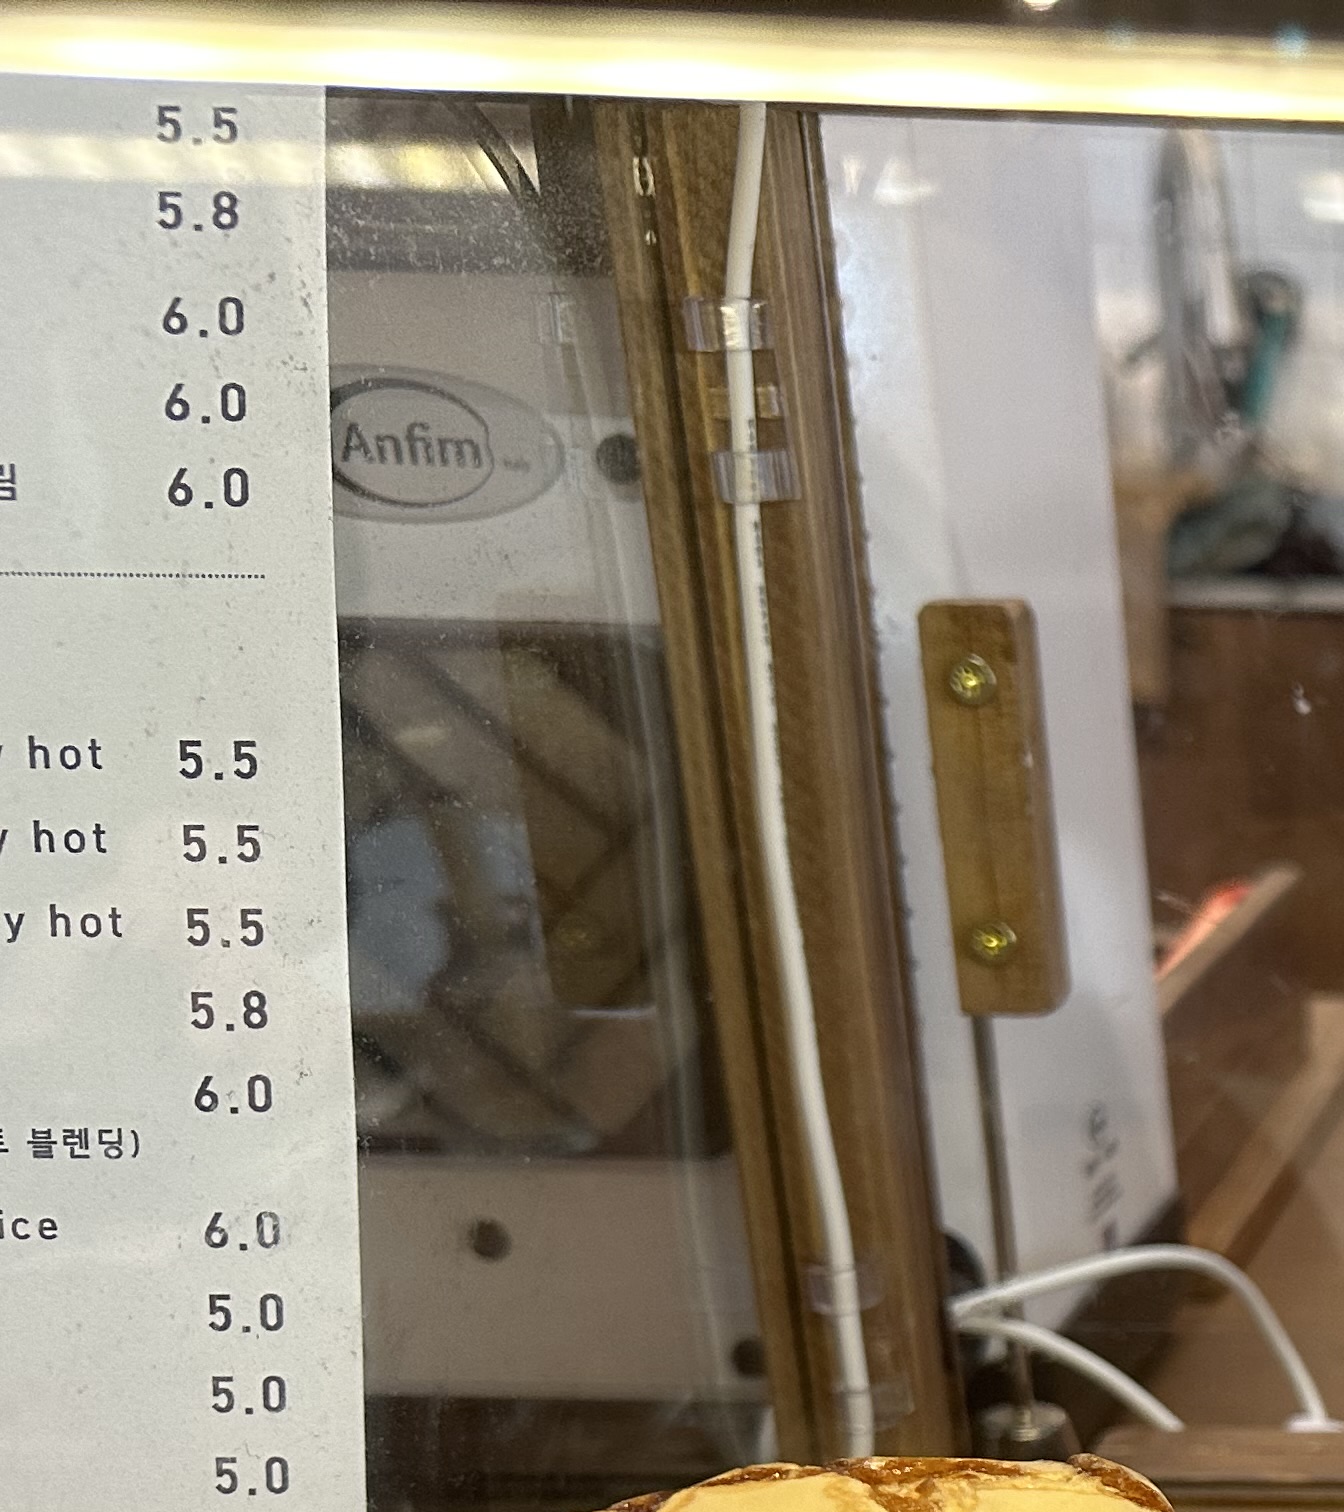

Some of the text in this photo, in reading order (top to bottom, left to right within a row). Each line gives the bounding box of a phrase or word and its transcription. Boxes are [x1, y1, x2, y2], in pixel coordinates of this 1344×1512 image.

[156, 105, 238, 144] 5.5
[157, 190, 239, 232] 5.8
[162, 296, 245, 338] 6.0
[164, 382, 247, 424] 6.0
[339, 419, 486, 468] Anfim
[167, 467, 250, 510] 6.0
[27, 734, 258, 781] hot 5.5
[32, 819, 107, 854] hot
[182, 824, 261, 865] 5.5
[49, 903, 123, 939] hot
[186, 907, 264, 949] 5.5
[190, 989, 268, 1032] 5.8
[194, 1074, 273, 1115] 6.0
[26, 1127, 140, 1160] 블렌딩)
[204, 1211, 281, 1252] 6.0
[208, 1293, 284, 1334] 5.0
[211, 1375, 287, 1415] 5.0
[215, 1456, 289, 1496] 5.0
